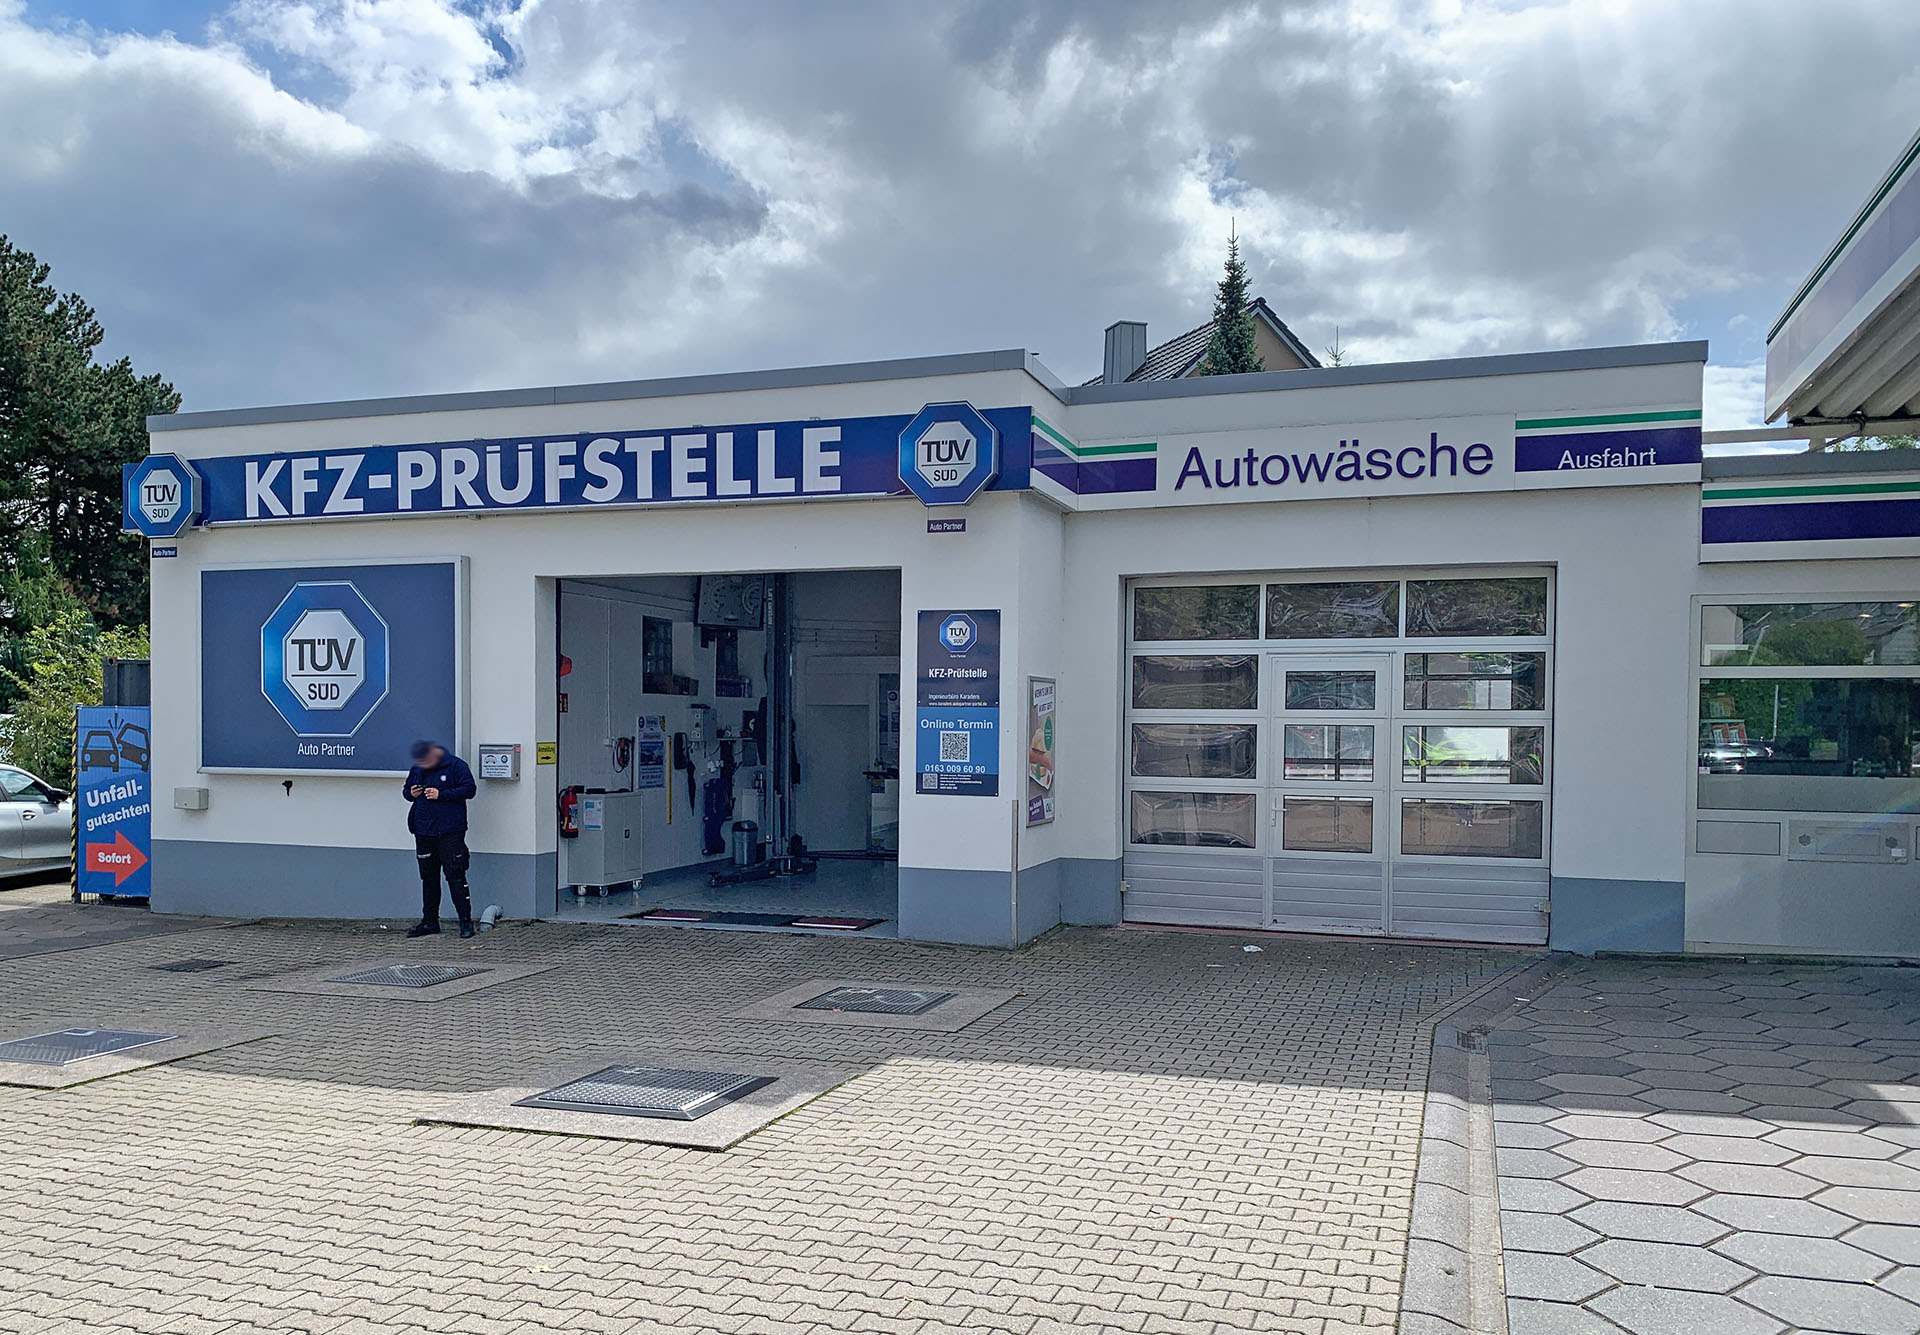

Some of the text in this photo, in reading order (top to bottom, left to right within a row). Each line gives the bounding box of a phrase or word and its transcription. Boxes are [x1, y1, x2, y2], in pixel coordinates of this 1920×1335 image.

[921, 439, 972, 463] TÜV
[1557, 447, 1657, 469] Ausfahrt
[1174, 432, 1494, 490] Autowäsche
[245, 426, 842, 518] KFZ-PRÜFSTELLE
[933, 469, 958, 481] SÜD
[143, 484, 177, 503] TÜV
[152, 508, 170, 519] SÜD
[929, 522, 963, 531] Auto Partner
[153, 548, 176, 557] Auto Partner
[949, 627, 968, 637] TÜV
[291, 638, 357, 671] TÜV
[928, 668, 988, 679] KFZ-Prüfstelle
[308, 683, 340, 701] SÜD
[920, 719, 993, 729] Online Termin
[297, 743, 355, 756] Auto Partner
[925, 764, 986, 774] 0163 009 60 90
[86, 779, 143, 808] Unfall-
[86, 802, 150, 832] gutachten
[97, 851, 132, 865] Sofort
